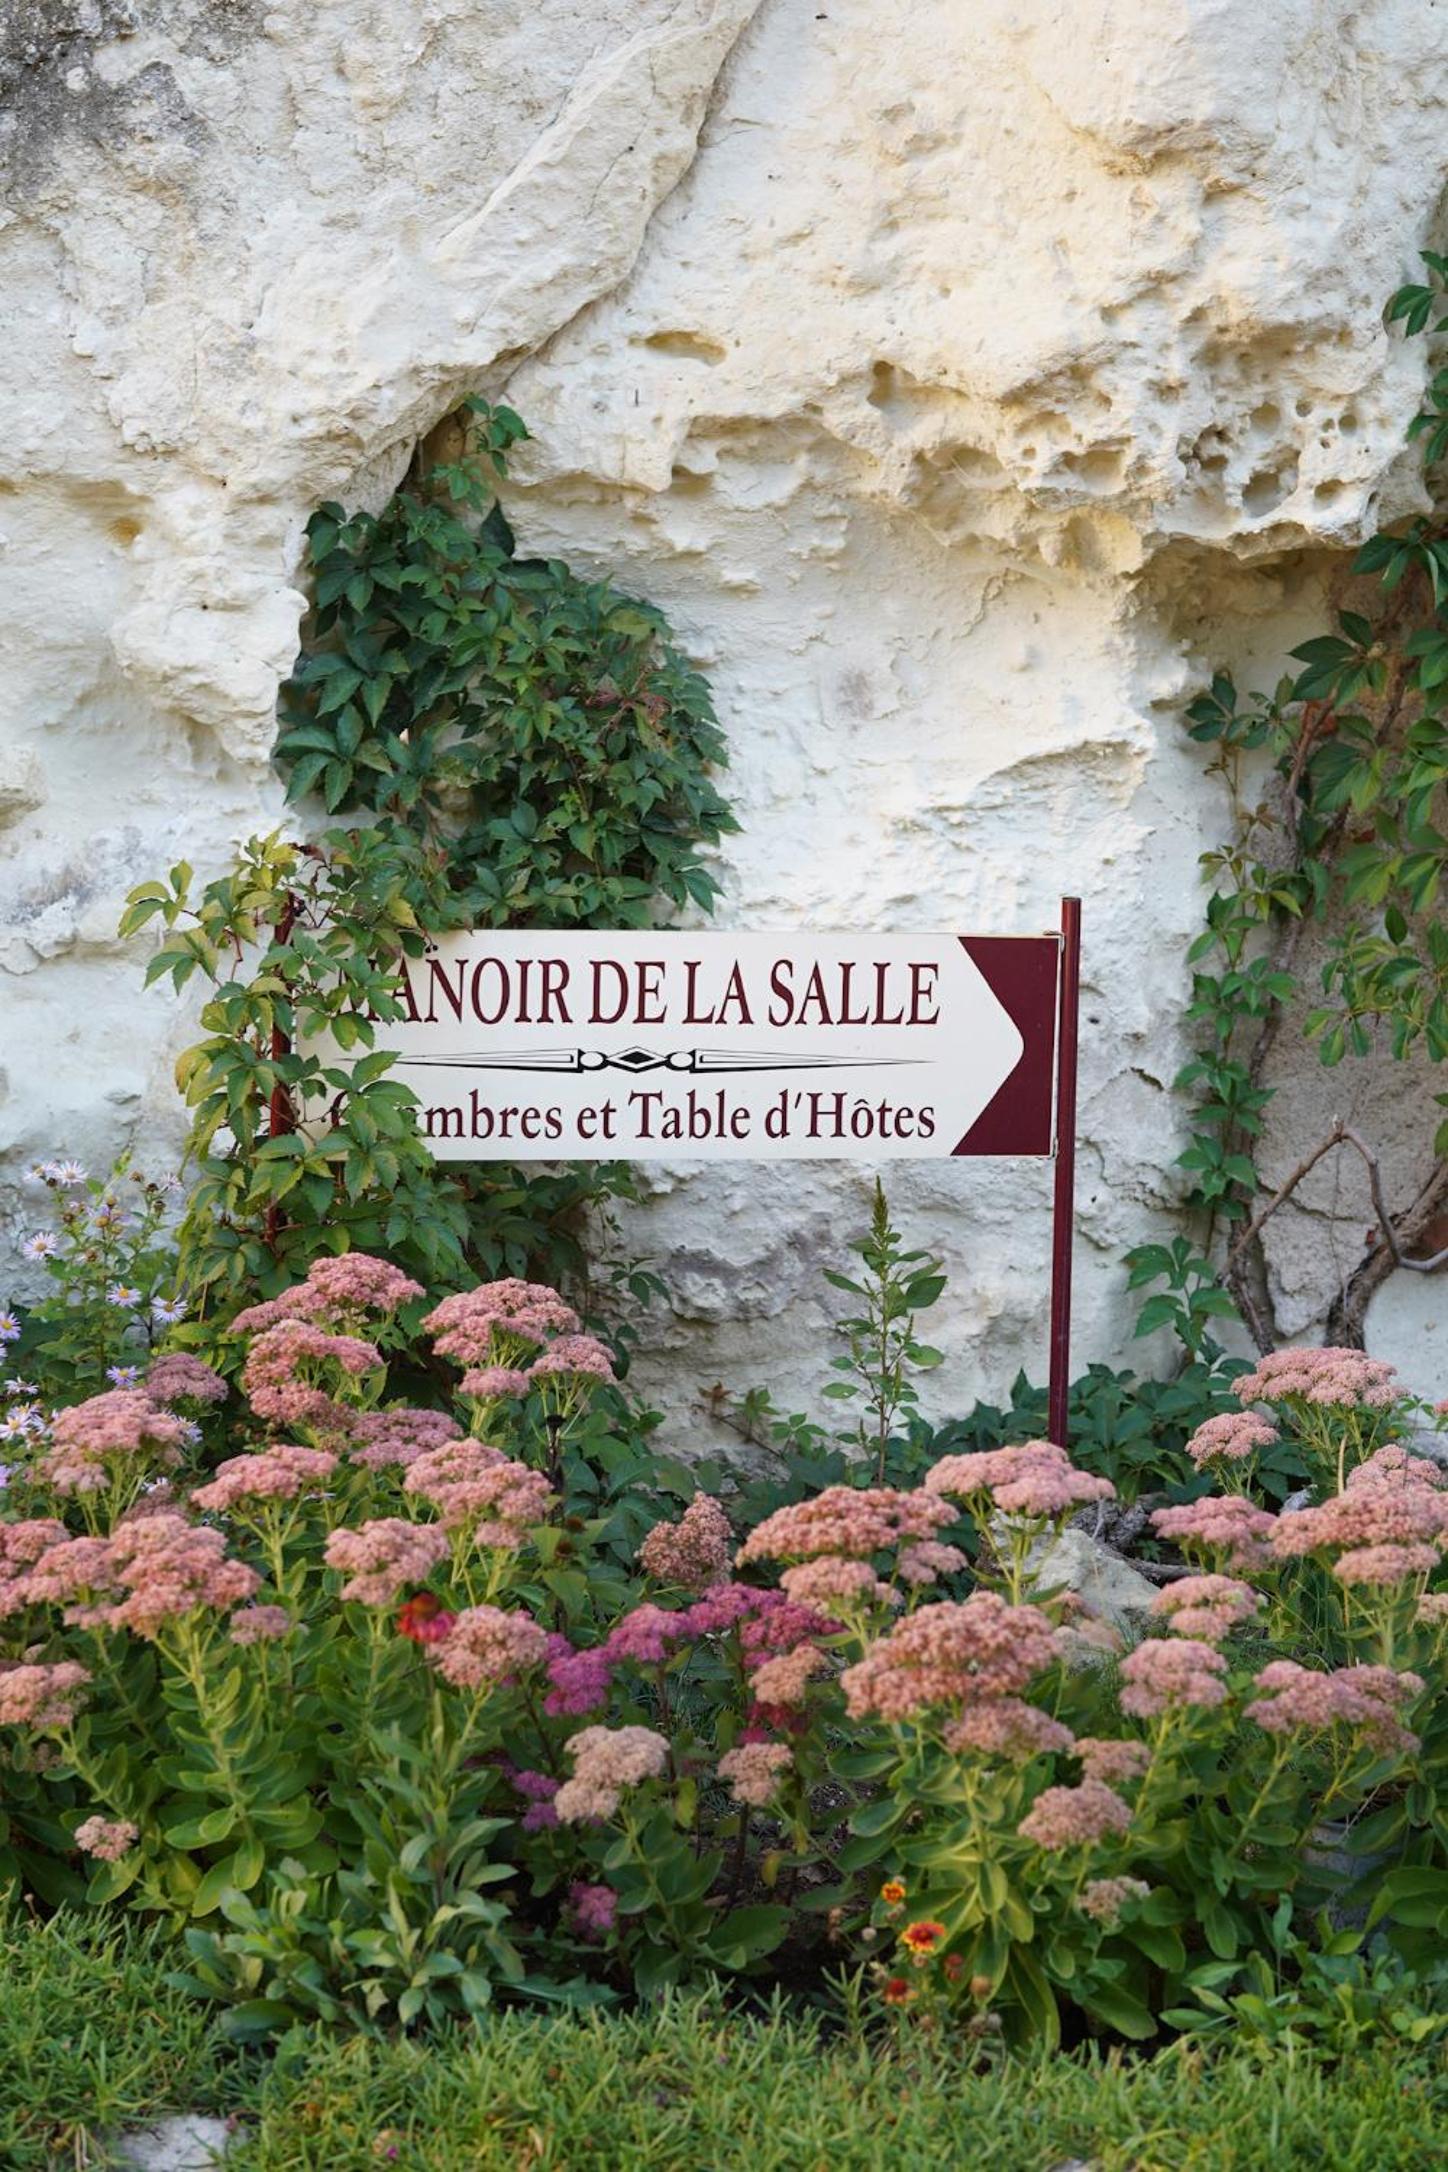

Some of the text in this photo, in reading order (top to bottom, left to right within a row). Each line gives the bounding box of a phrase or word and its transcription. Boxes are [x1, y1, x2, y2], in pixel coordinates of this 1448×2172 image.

[587, 960, 668, 1025] DE
[681, 959, 755, 1026] LA
[768, 959, 941, 1028] SALLE
[330, 1088, 935, 1140] mbres et Table d'Hôtes
